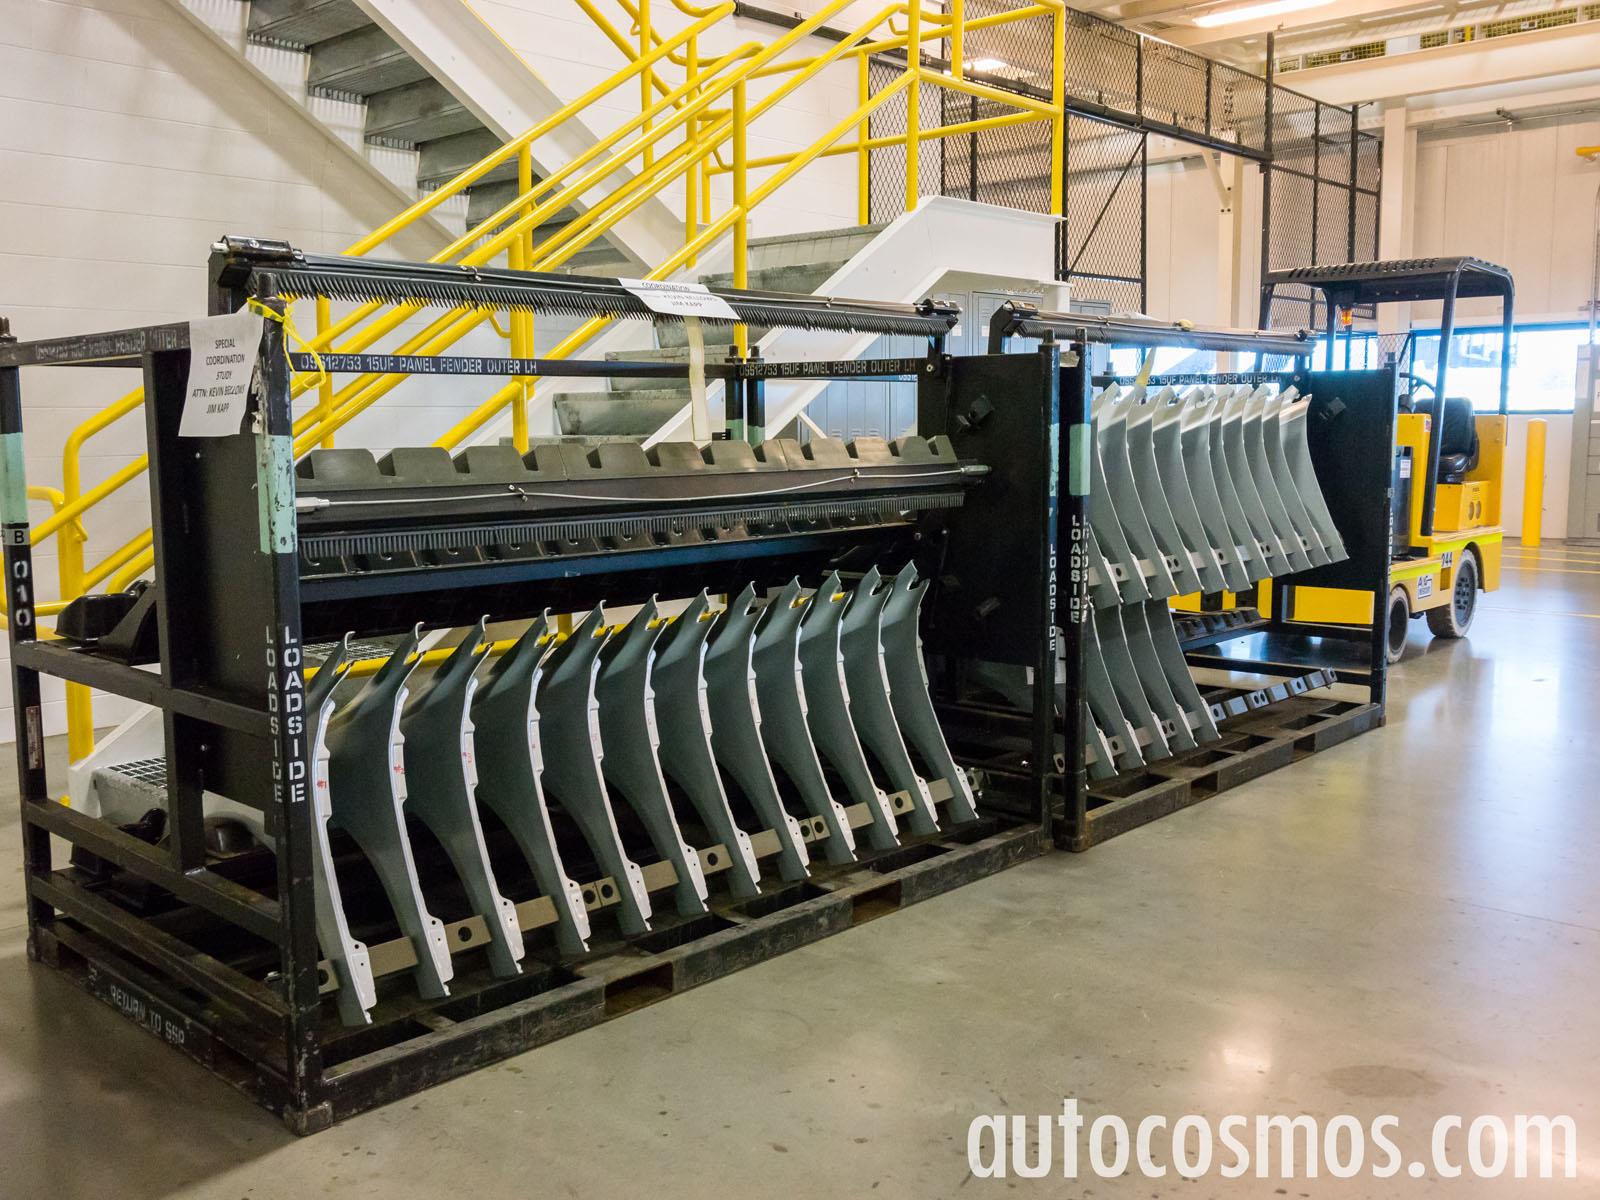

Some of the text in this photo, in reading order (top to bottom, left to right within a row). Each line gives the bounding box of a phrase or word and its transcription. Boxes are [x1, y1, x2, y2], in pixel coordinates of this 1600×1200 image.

[214, 338, 236, 350] SPECIAL
[205, 354, 245, 366] COORDINATION
[366, 355, 395, 371] 15UF
[399, 356, 436, 372] PANEL
[440, 357, 483, 373] FENDER
[487, 358, 521, 374] OUTER
[524, 359, 538, 375] LH
[780, 362, 800, 376] 15UF
[803, 361, 830, 375] PANEL
[833, 360, 867, 374] FENDER
[871, 358, 900, 373] OUTER
[215, 370, 233, 381] STUDY
[1179, 375, 1204, 385] PANEL
[1207, 374, 1237, 385] FENDER
[1241, 374, 1268, 384] OUTER
[208, 386, 224, 398] KEVIN
[14, 530, 25, 544] B
[1069, 514, 1081, 624] LOADSIDE
[1049, 543, 1057, 651] LOADSIDE
[266, 625, 283, 803] LOADSIDE
[283, 626, 306, 803] LOADSIDE
